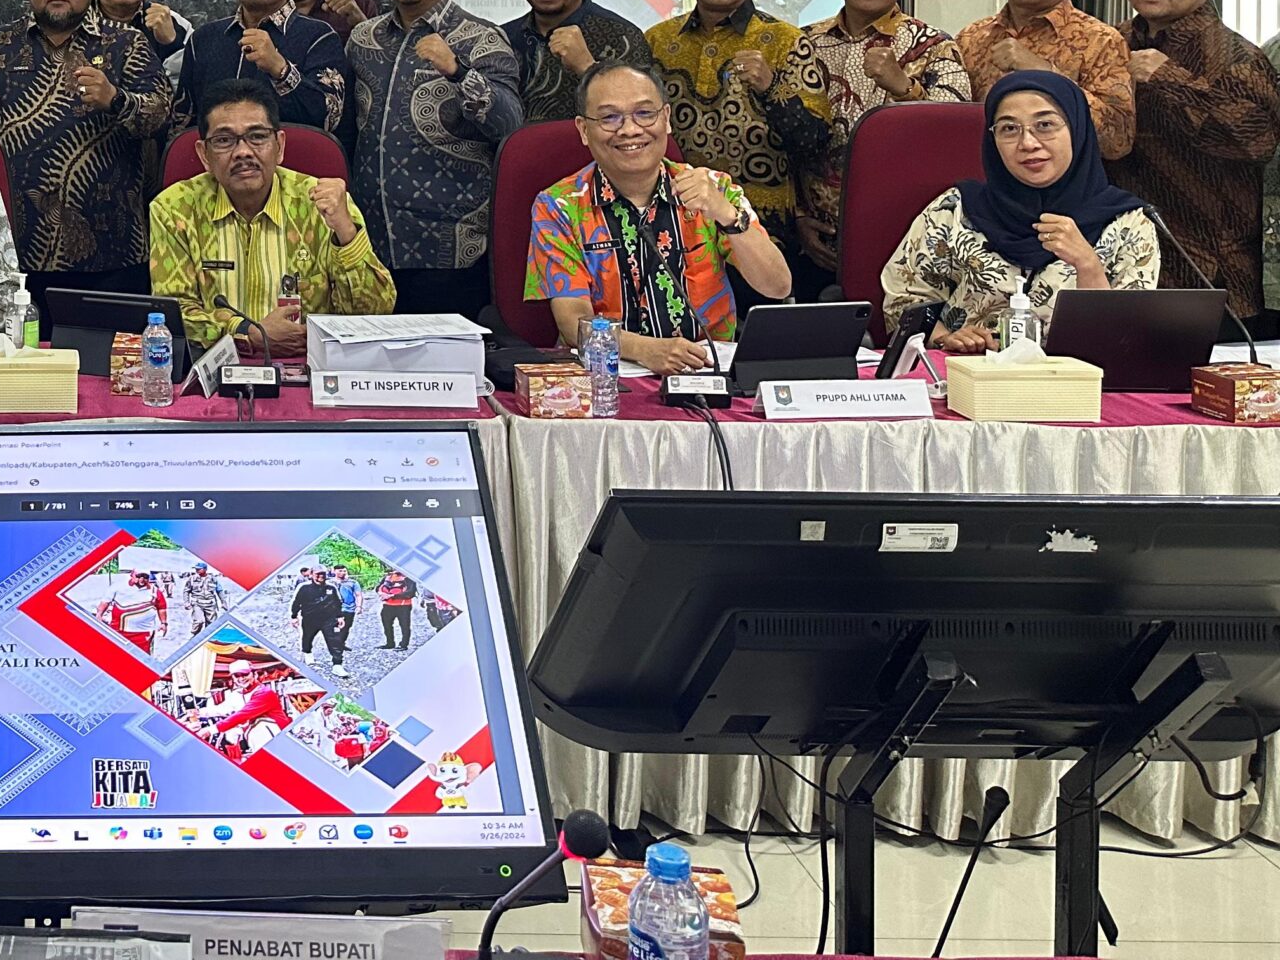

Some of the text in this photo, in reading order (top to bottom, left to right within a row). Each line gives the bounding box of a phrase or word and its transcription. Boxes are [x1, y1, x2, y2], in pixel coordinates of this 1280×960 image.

[351, 381, 454, 391] PLT INSPEKTUR IV
[815, 393, 907, 402] PPUPD AHLI UTAMA
[20, 441, 62, 449] PowerPoint
[114, 501, 134, 510] 74%
[33, 657, 81, 668] KOTA
[94, 759, 150, 772] BERSATU
[94, 770, 152, 794] KITA
[93, 791, 157, 807] JUARA!
[480, 832, 526, 840] 9/26/2024
[204, 939, 376, 960] PENJABAT BUPATI
